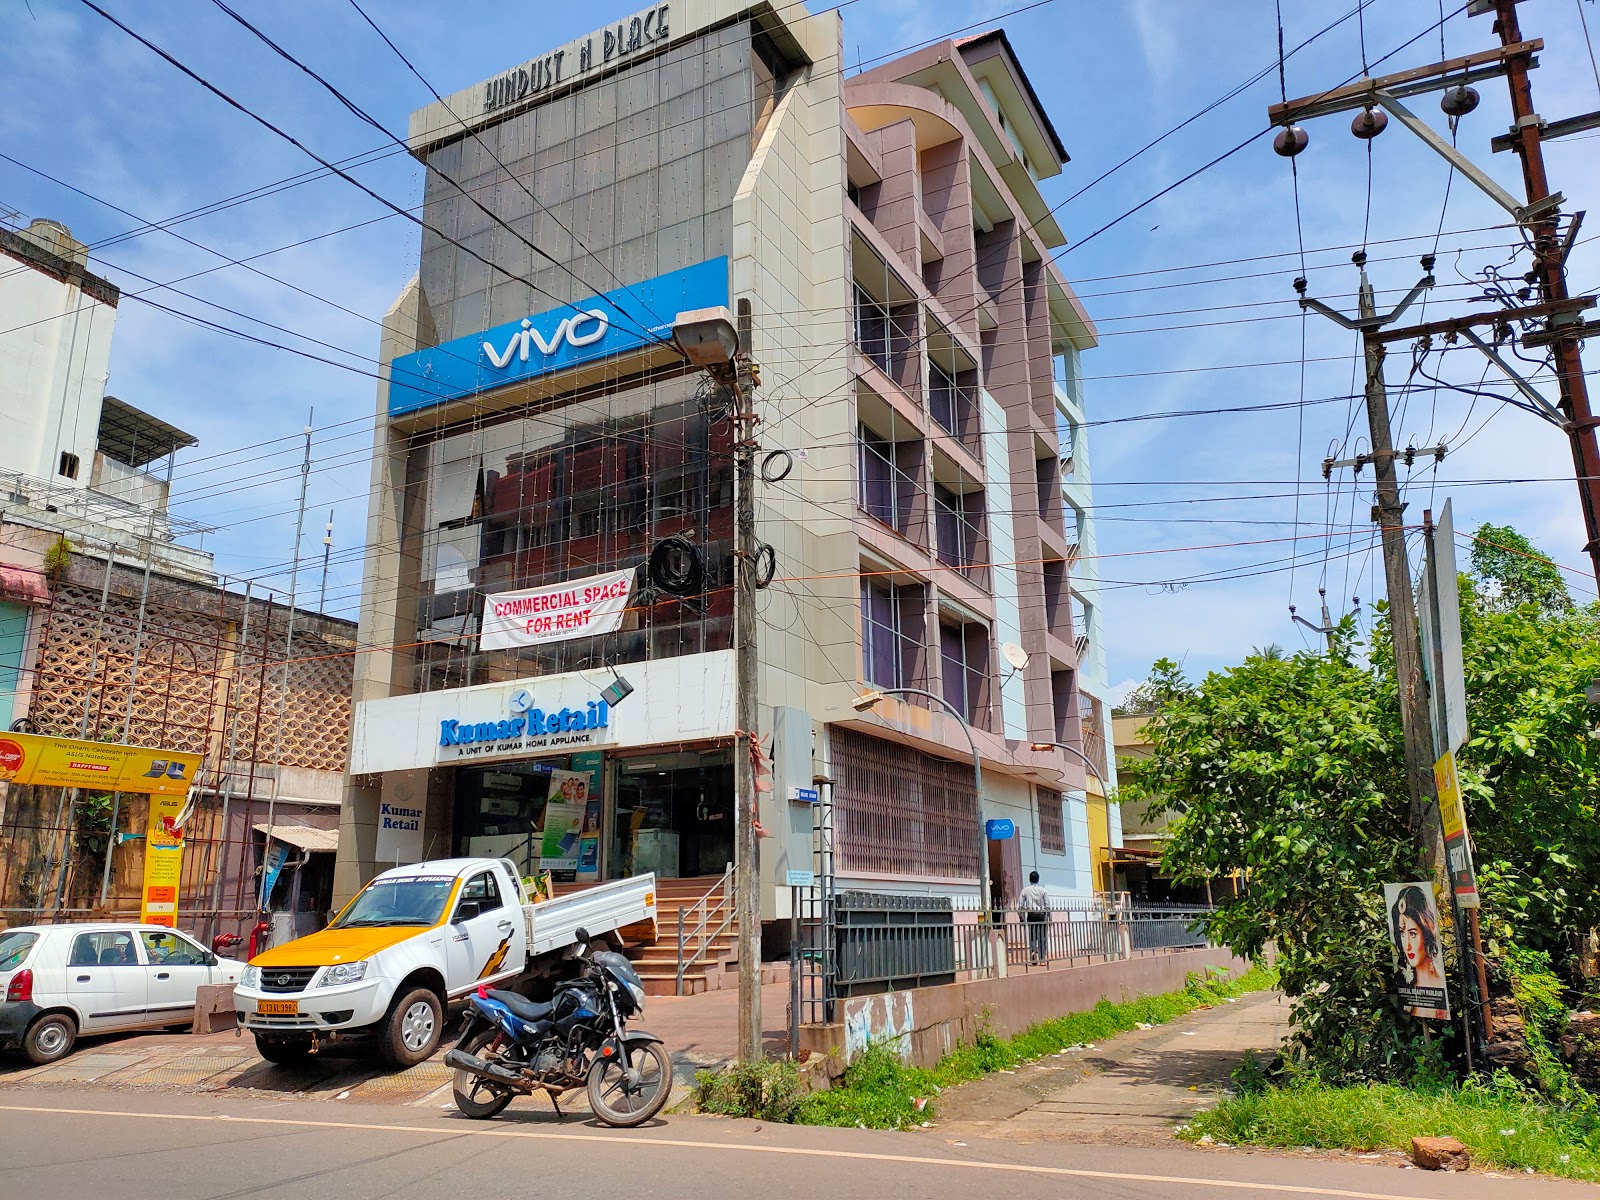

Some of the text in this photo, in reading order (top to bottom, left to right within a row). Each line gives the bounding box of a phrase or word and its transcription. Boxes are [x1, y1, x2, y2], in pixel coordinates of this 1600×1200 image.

[603, 4, 670, 62] PLACE
[483, 308, 609, 368] vivo
[495, 580, 628, 617] COMMERCIAL SPACE
[525, 609, 592, 635] FOR RENT
[438, 700, 609, 747] Kumar Retail
[53, 742, 68, 750] This
[68, 744, 91, 752] Onam,
[91, 747, 123, 756] Celebrate
[458, 748, 464, 756] A
[466, 746, 482, 755] UNIT
[485, 745, 495, 753] OF
[497, 742, 523, 751] KUMAR
[526, 739, 548, 748] HOME
[381, 803, 423, 831] Kumar Retail
